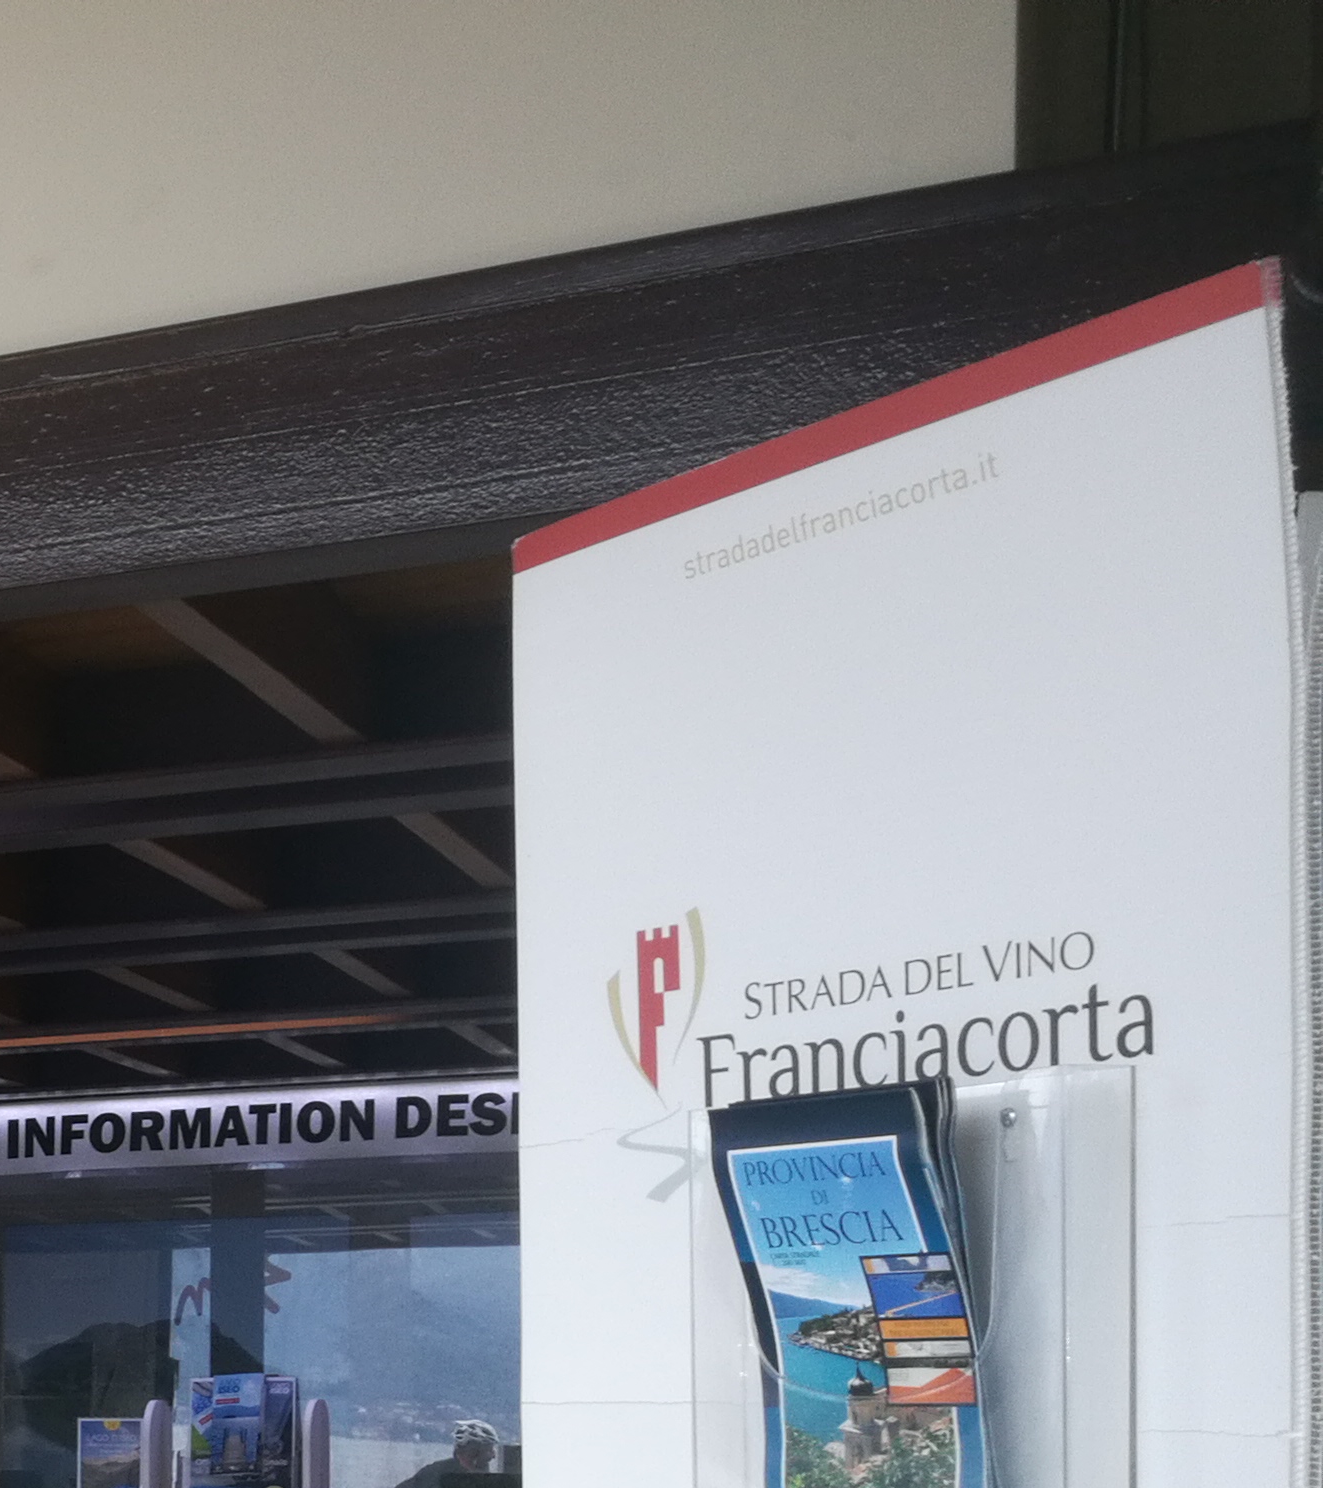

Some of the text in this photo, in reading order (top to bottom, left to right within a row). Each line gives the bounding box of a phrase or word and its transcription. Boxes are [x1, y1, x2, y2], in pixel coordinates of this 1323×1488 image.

[683, 452, 1000, 580] stradadelfranciacorta.it
[744, 931, 1095, 1020] STRADA DEL VINO
[697, 984, 1155, 1108] Franciacorta
[6, 1092, 519, 1160] INFORMATION DES
[743, 1151, 887, 1186] PROVINCIA
[811, 1189, 829, 1206] DI
[760, 1209, 904, 1249] BRESCIA
